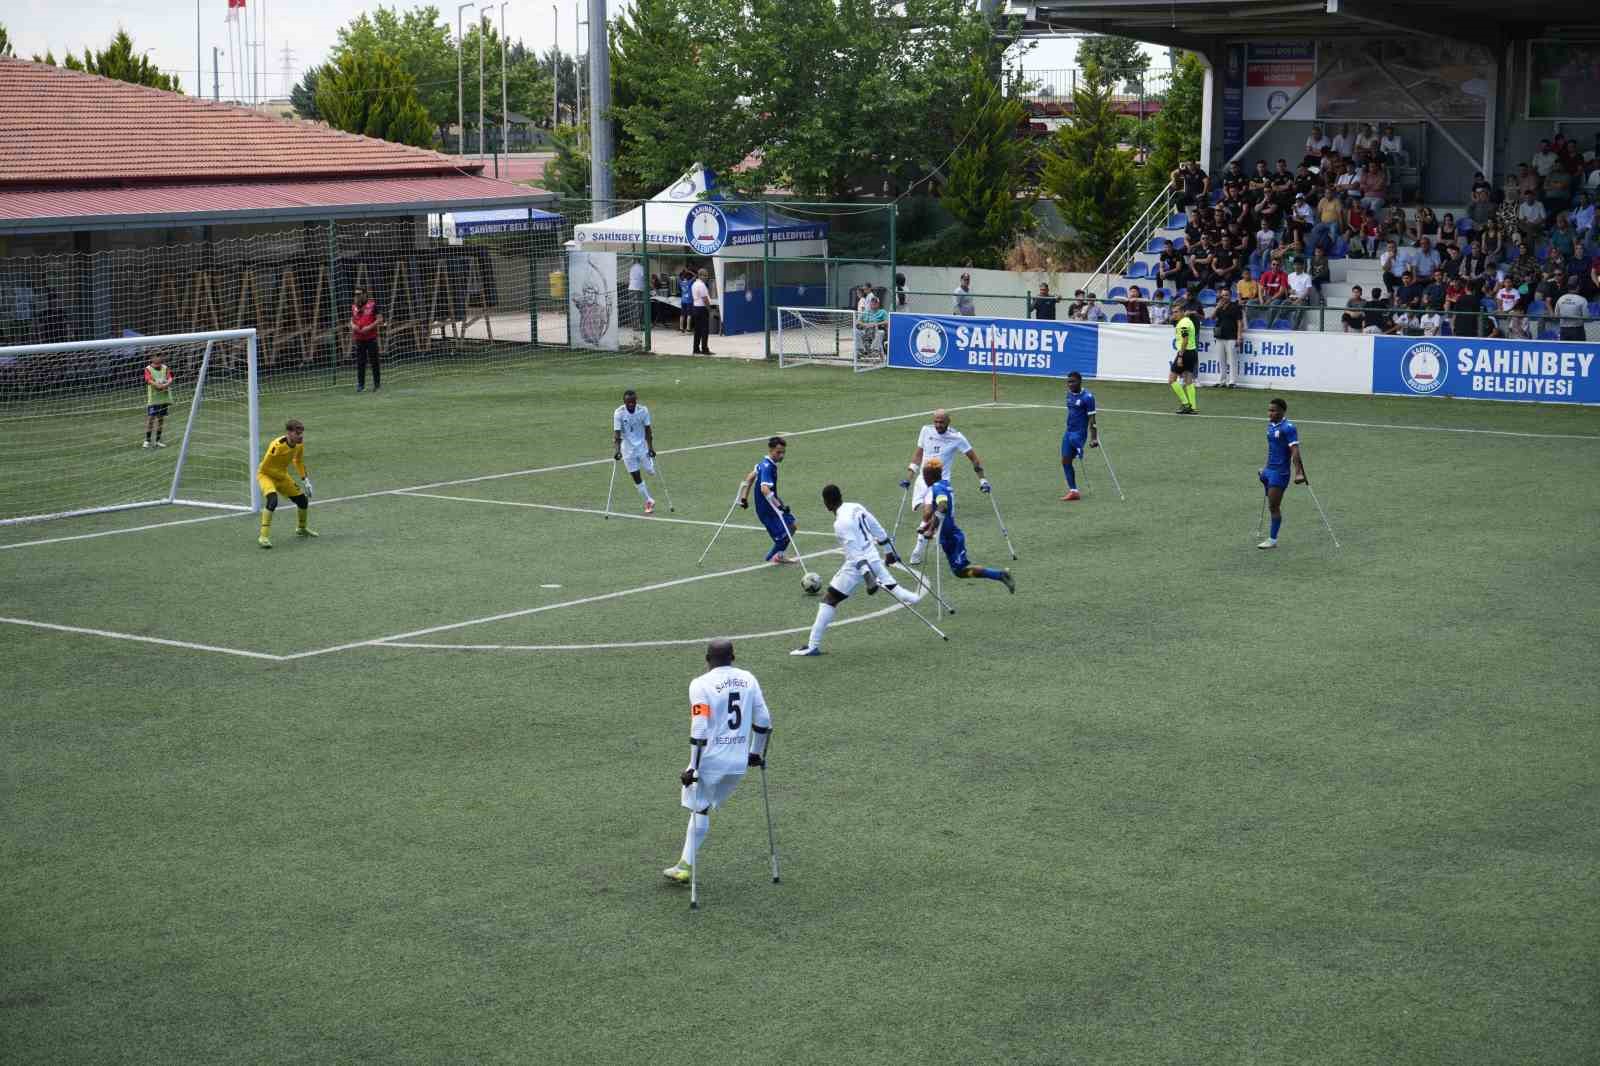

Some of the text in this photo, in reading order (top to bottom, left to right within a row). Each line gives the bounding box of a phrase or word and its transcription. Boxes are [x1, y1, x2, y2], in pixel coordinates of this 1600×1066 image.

[1262, 341, 1295, 356] Hızlı
[1244, 361, 1296, 377] Hizmet
[693, 704, 702, 716] C
[728, 692, 741, 730] 5
